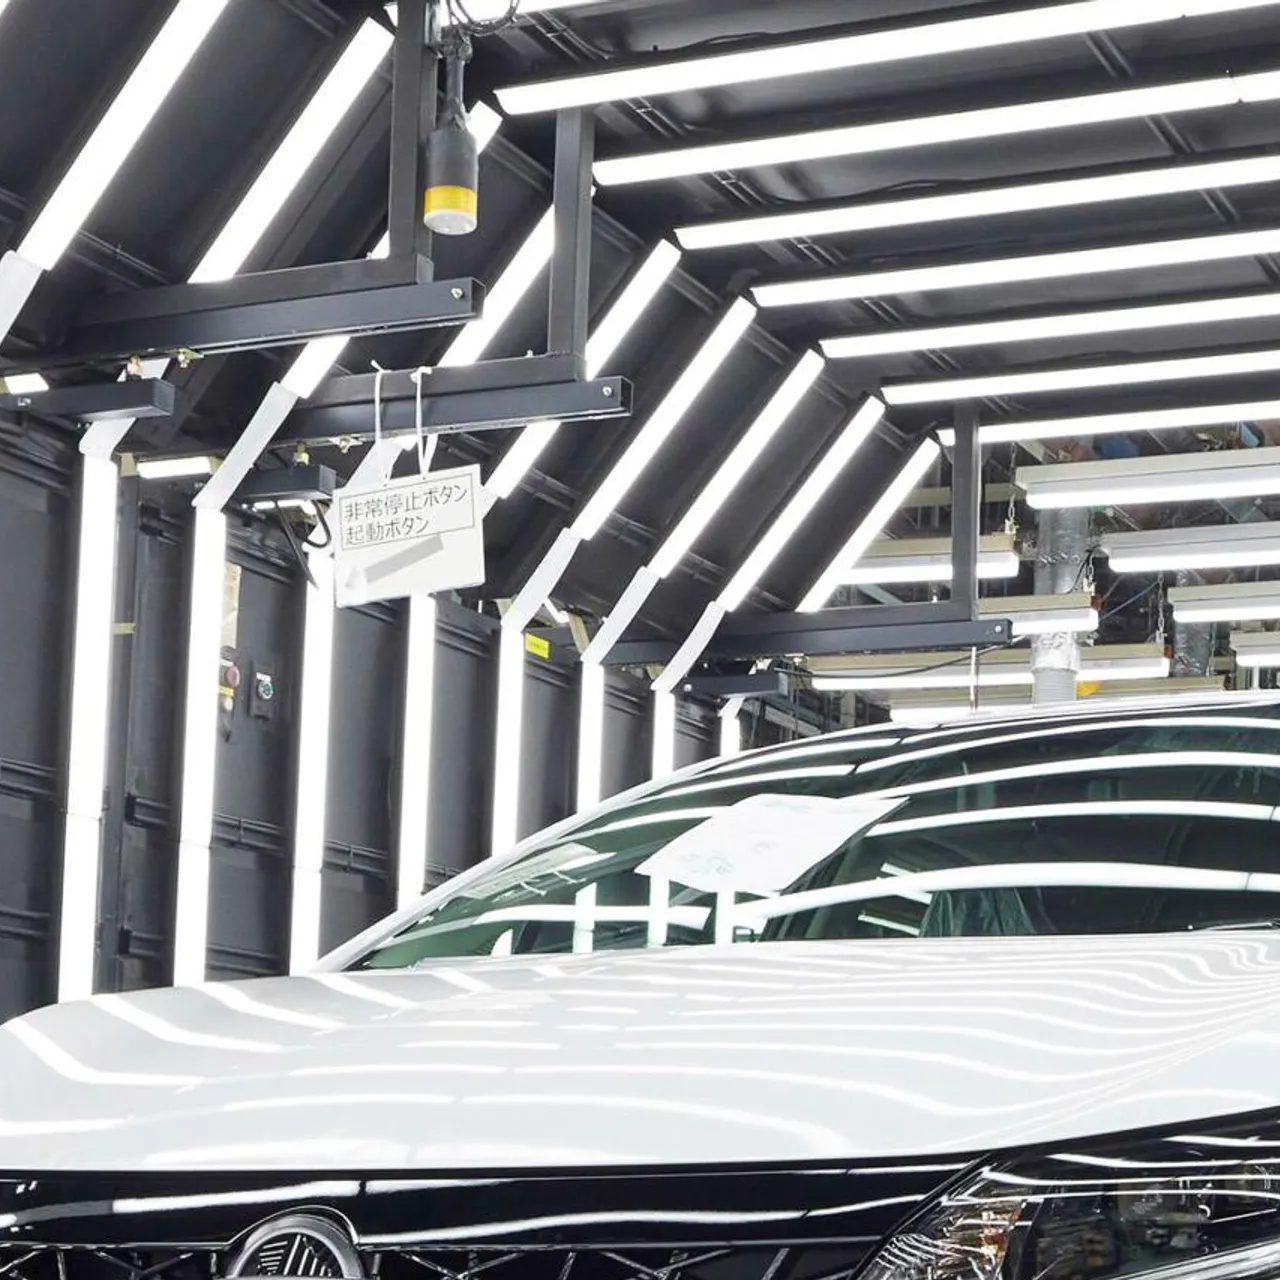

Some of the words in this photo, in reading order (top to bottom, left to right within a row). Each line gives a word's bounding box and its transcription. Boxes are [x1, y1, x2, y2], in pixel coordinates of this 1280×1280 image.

[344, 485, 467, 521] 非常停止ボタン
[345, 516, 429, 546] 起動ボタン
